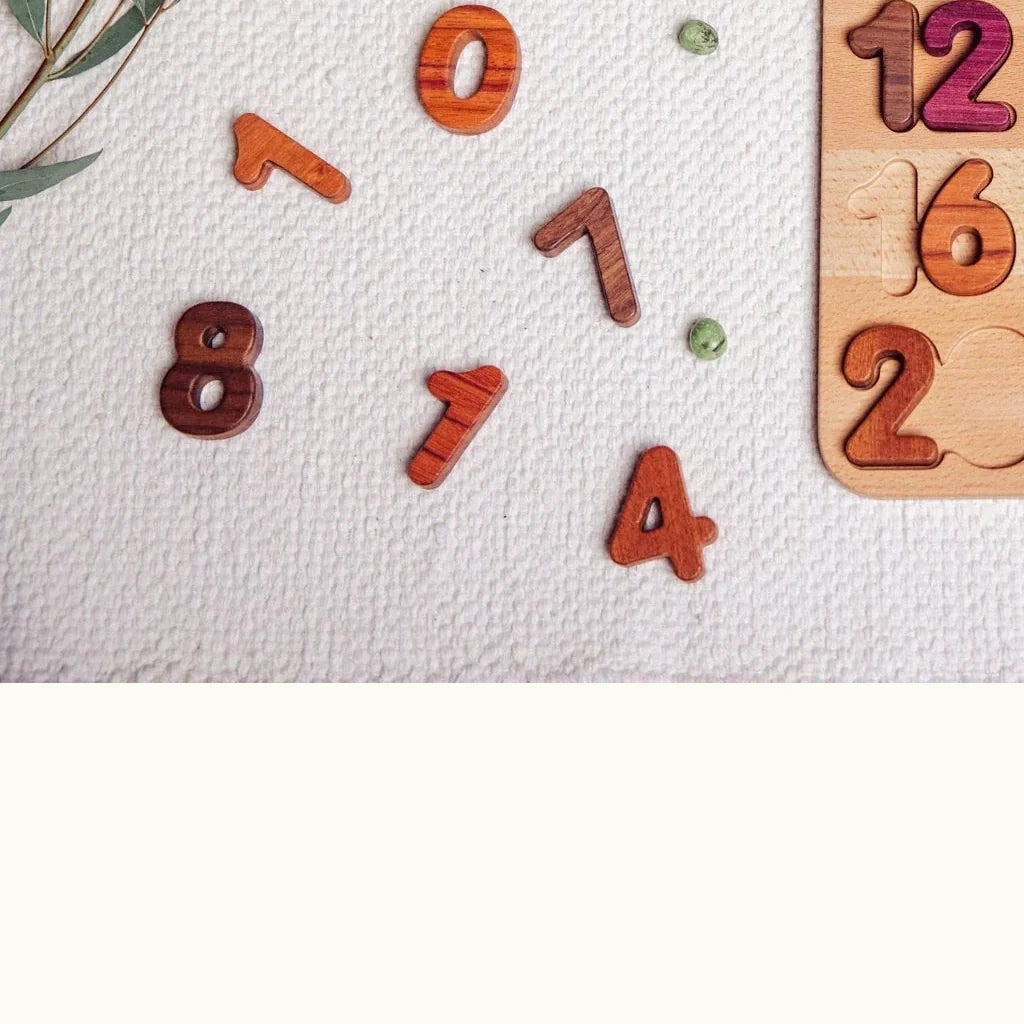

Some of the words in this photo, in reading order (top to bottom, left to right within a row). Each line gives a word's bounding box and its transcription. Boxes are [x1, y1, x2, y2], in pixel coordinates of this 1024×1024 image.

[416, 4, 522, 136] 0
[847, 157, 1017, 297] 16
[160, 301, 263, 441] 8
[407, 365, 508, 490] 1
[609, 445, 719, 584] 4
